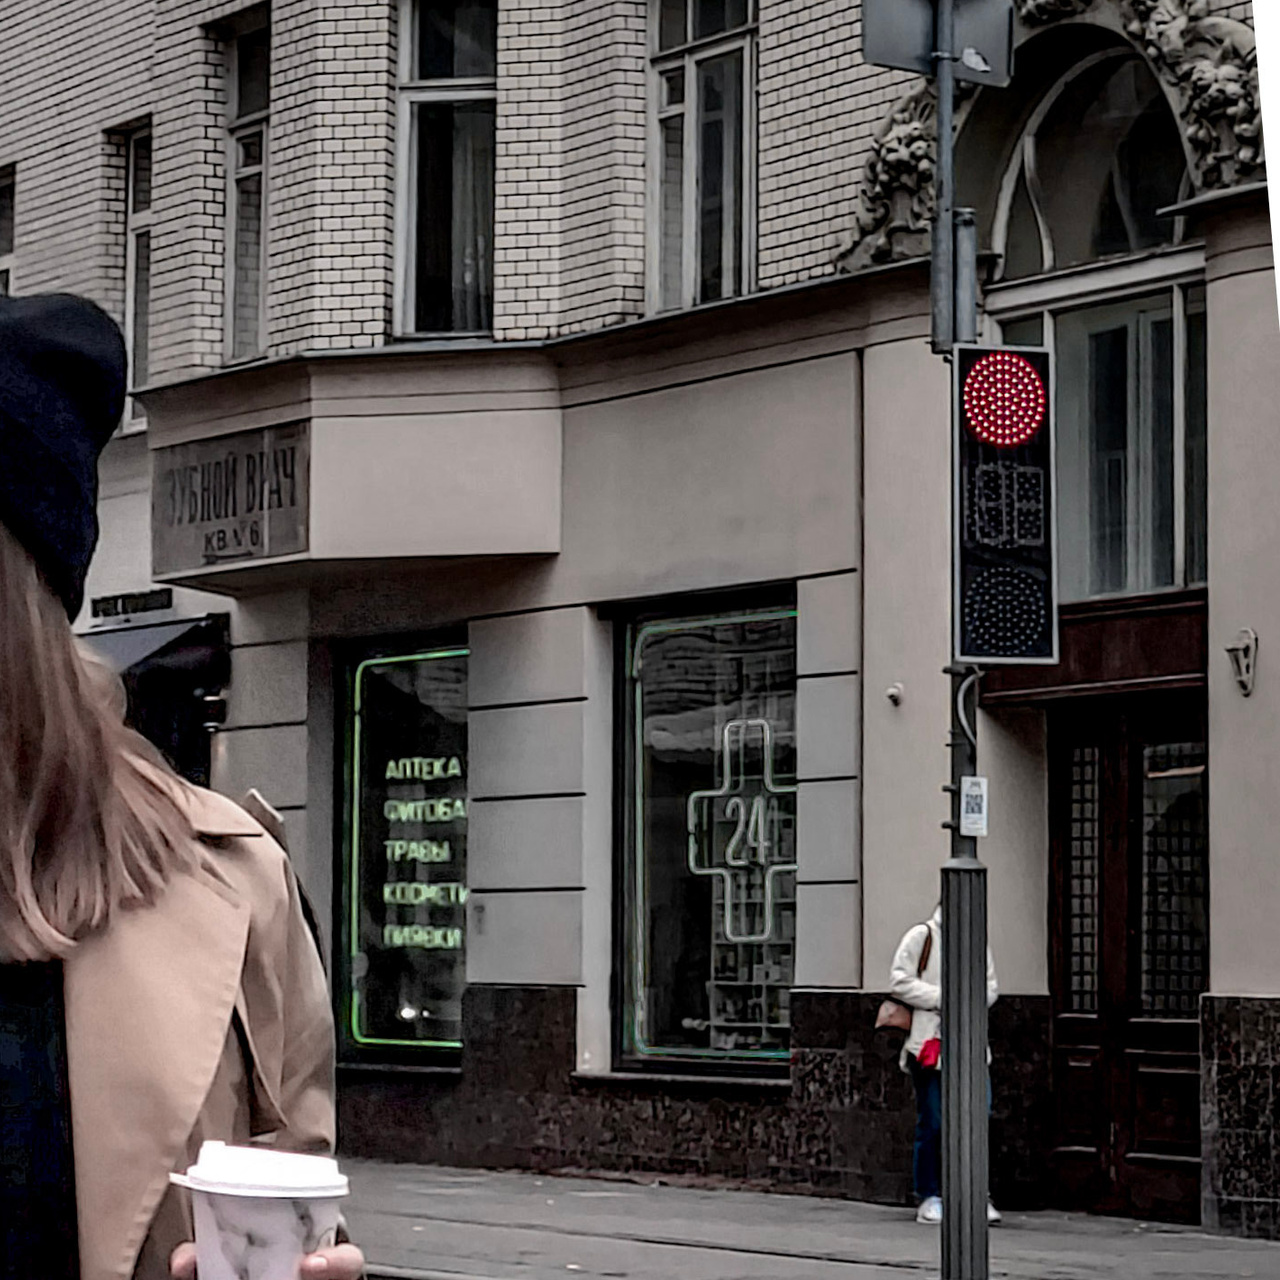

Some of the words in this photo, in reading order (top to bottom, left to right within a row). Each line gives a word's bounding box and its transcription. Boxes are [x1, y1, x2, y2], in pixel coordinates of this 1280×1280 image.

[385, 756, 461, 780] АПТЕКА
[725, 796, 771, 866] 24
[383, 840, 451, 863] ТРАВЫ
